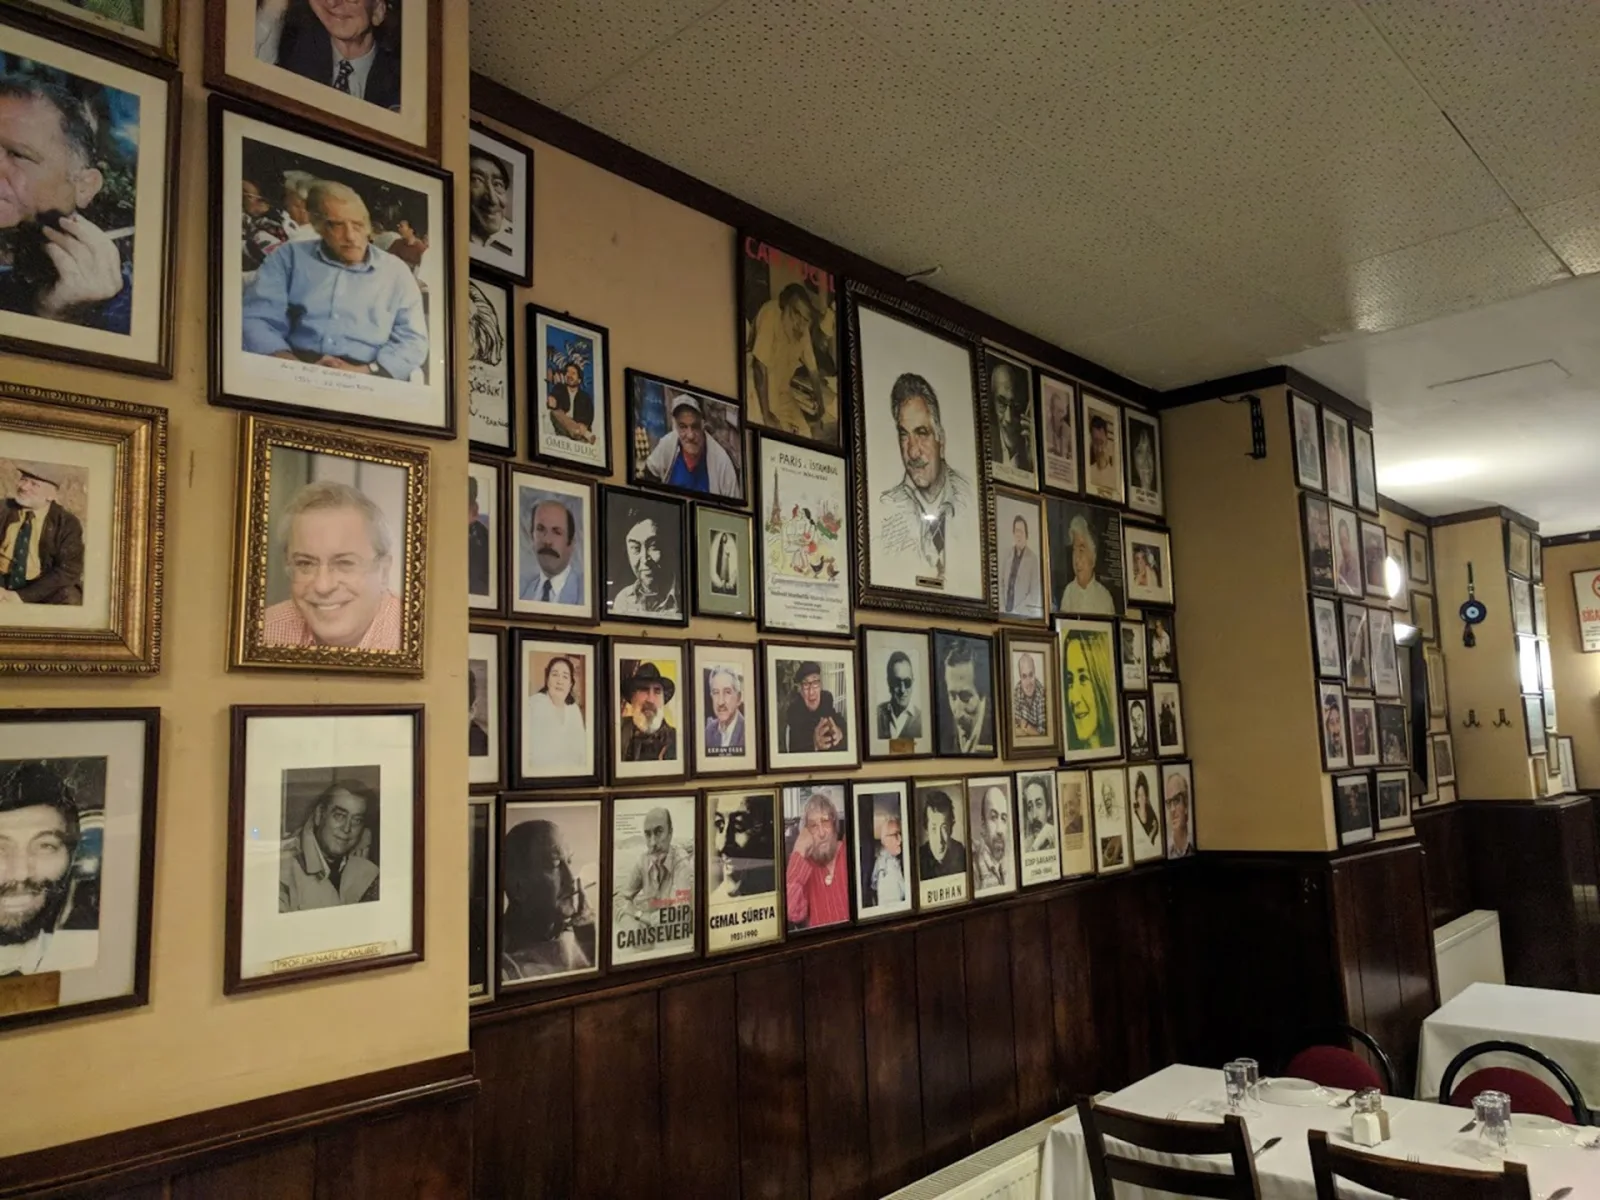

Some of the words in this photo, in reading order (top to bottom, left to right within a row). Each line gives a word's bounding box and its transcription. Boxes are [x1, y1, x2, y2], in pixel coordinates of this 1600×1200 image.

[927, 885, 962, 903] BURHAN
[710, 912, 739, 929] CEMAL
[741, 906, 775, 924] SÜREYA
[616, 922, 690, 949] CANSEVER
